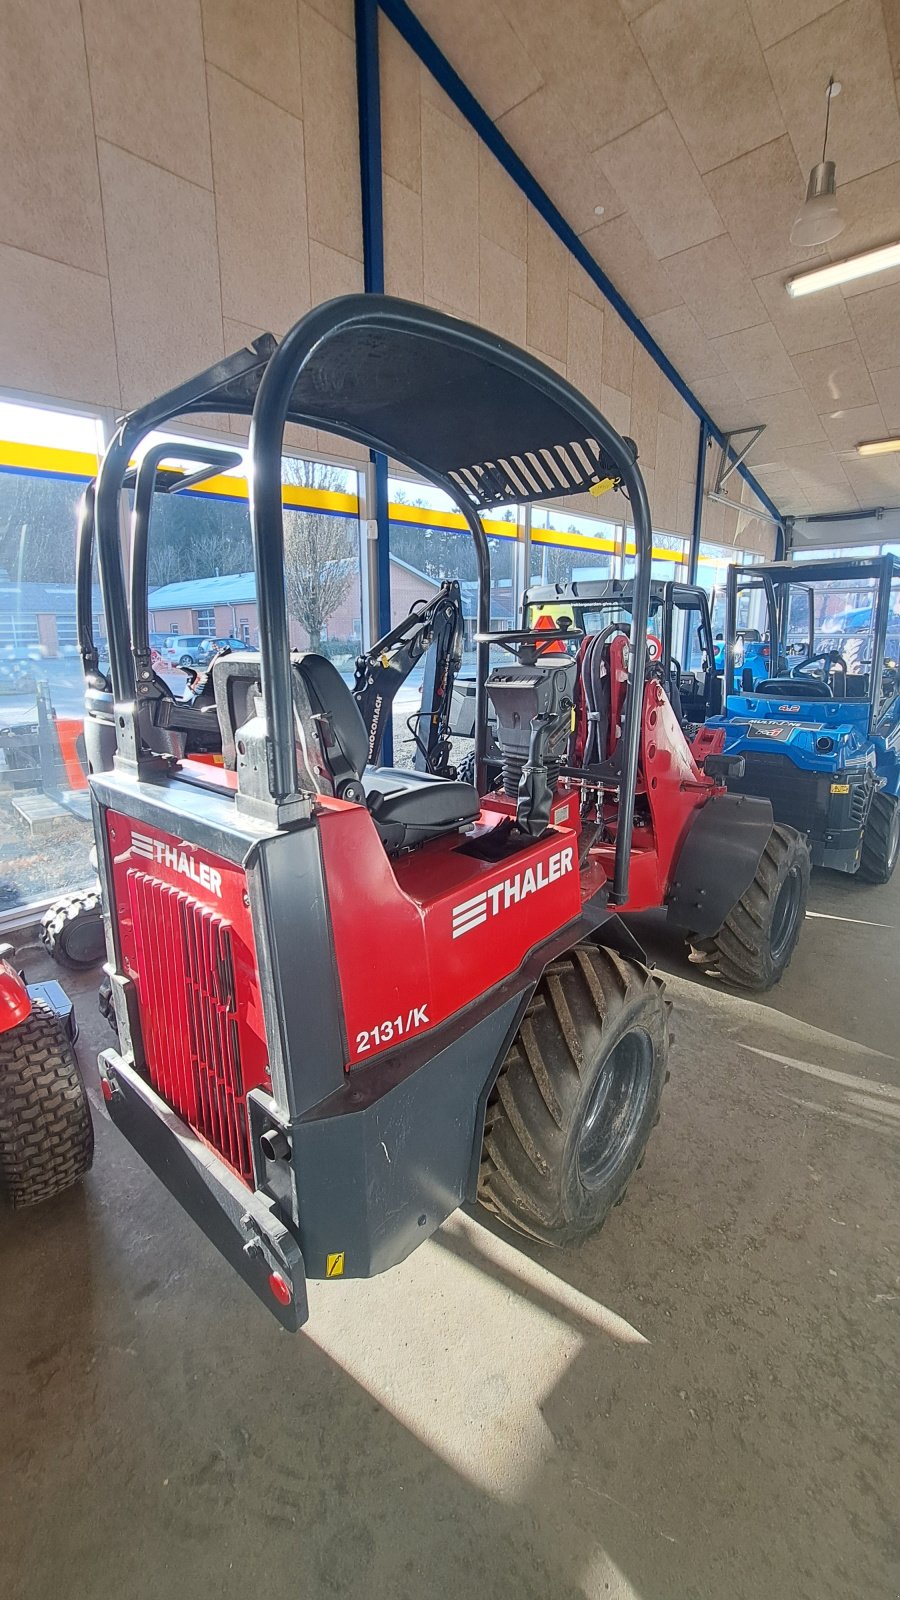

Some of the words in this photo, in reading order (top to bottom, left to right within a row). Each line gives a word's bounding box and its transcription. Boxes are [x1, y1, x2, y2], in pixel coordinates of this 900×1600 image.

[778, 704, 800, 712] 4.2
[153, 839, 222, 898] THALER
[487, 847, 573, 916] THALER
[356, 1003, 430, 1054] 2131/K
